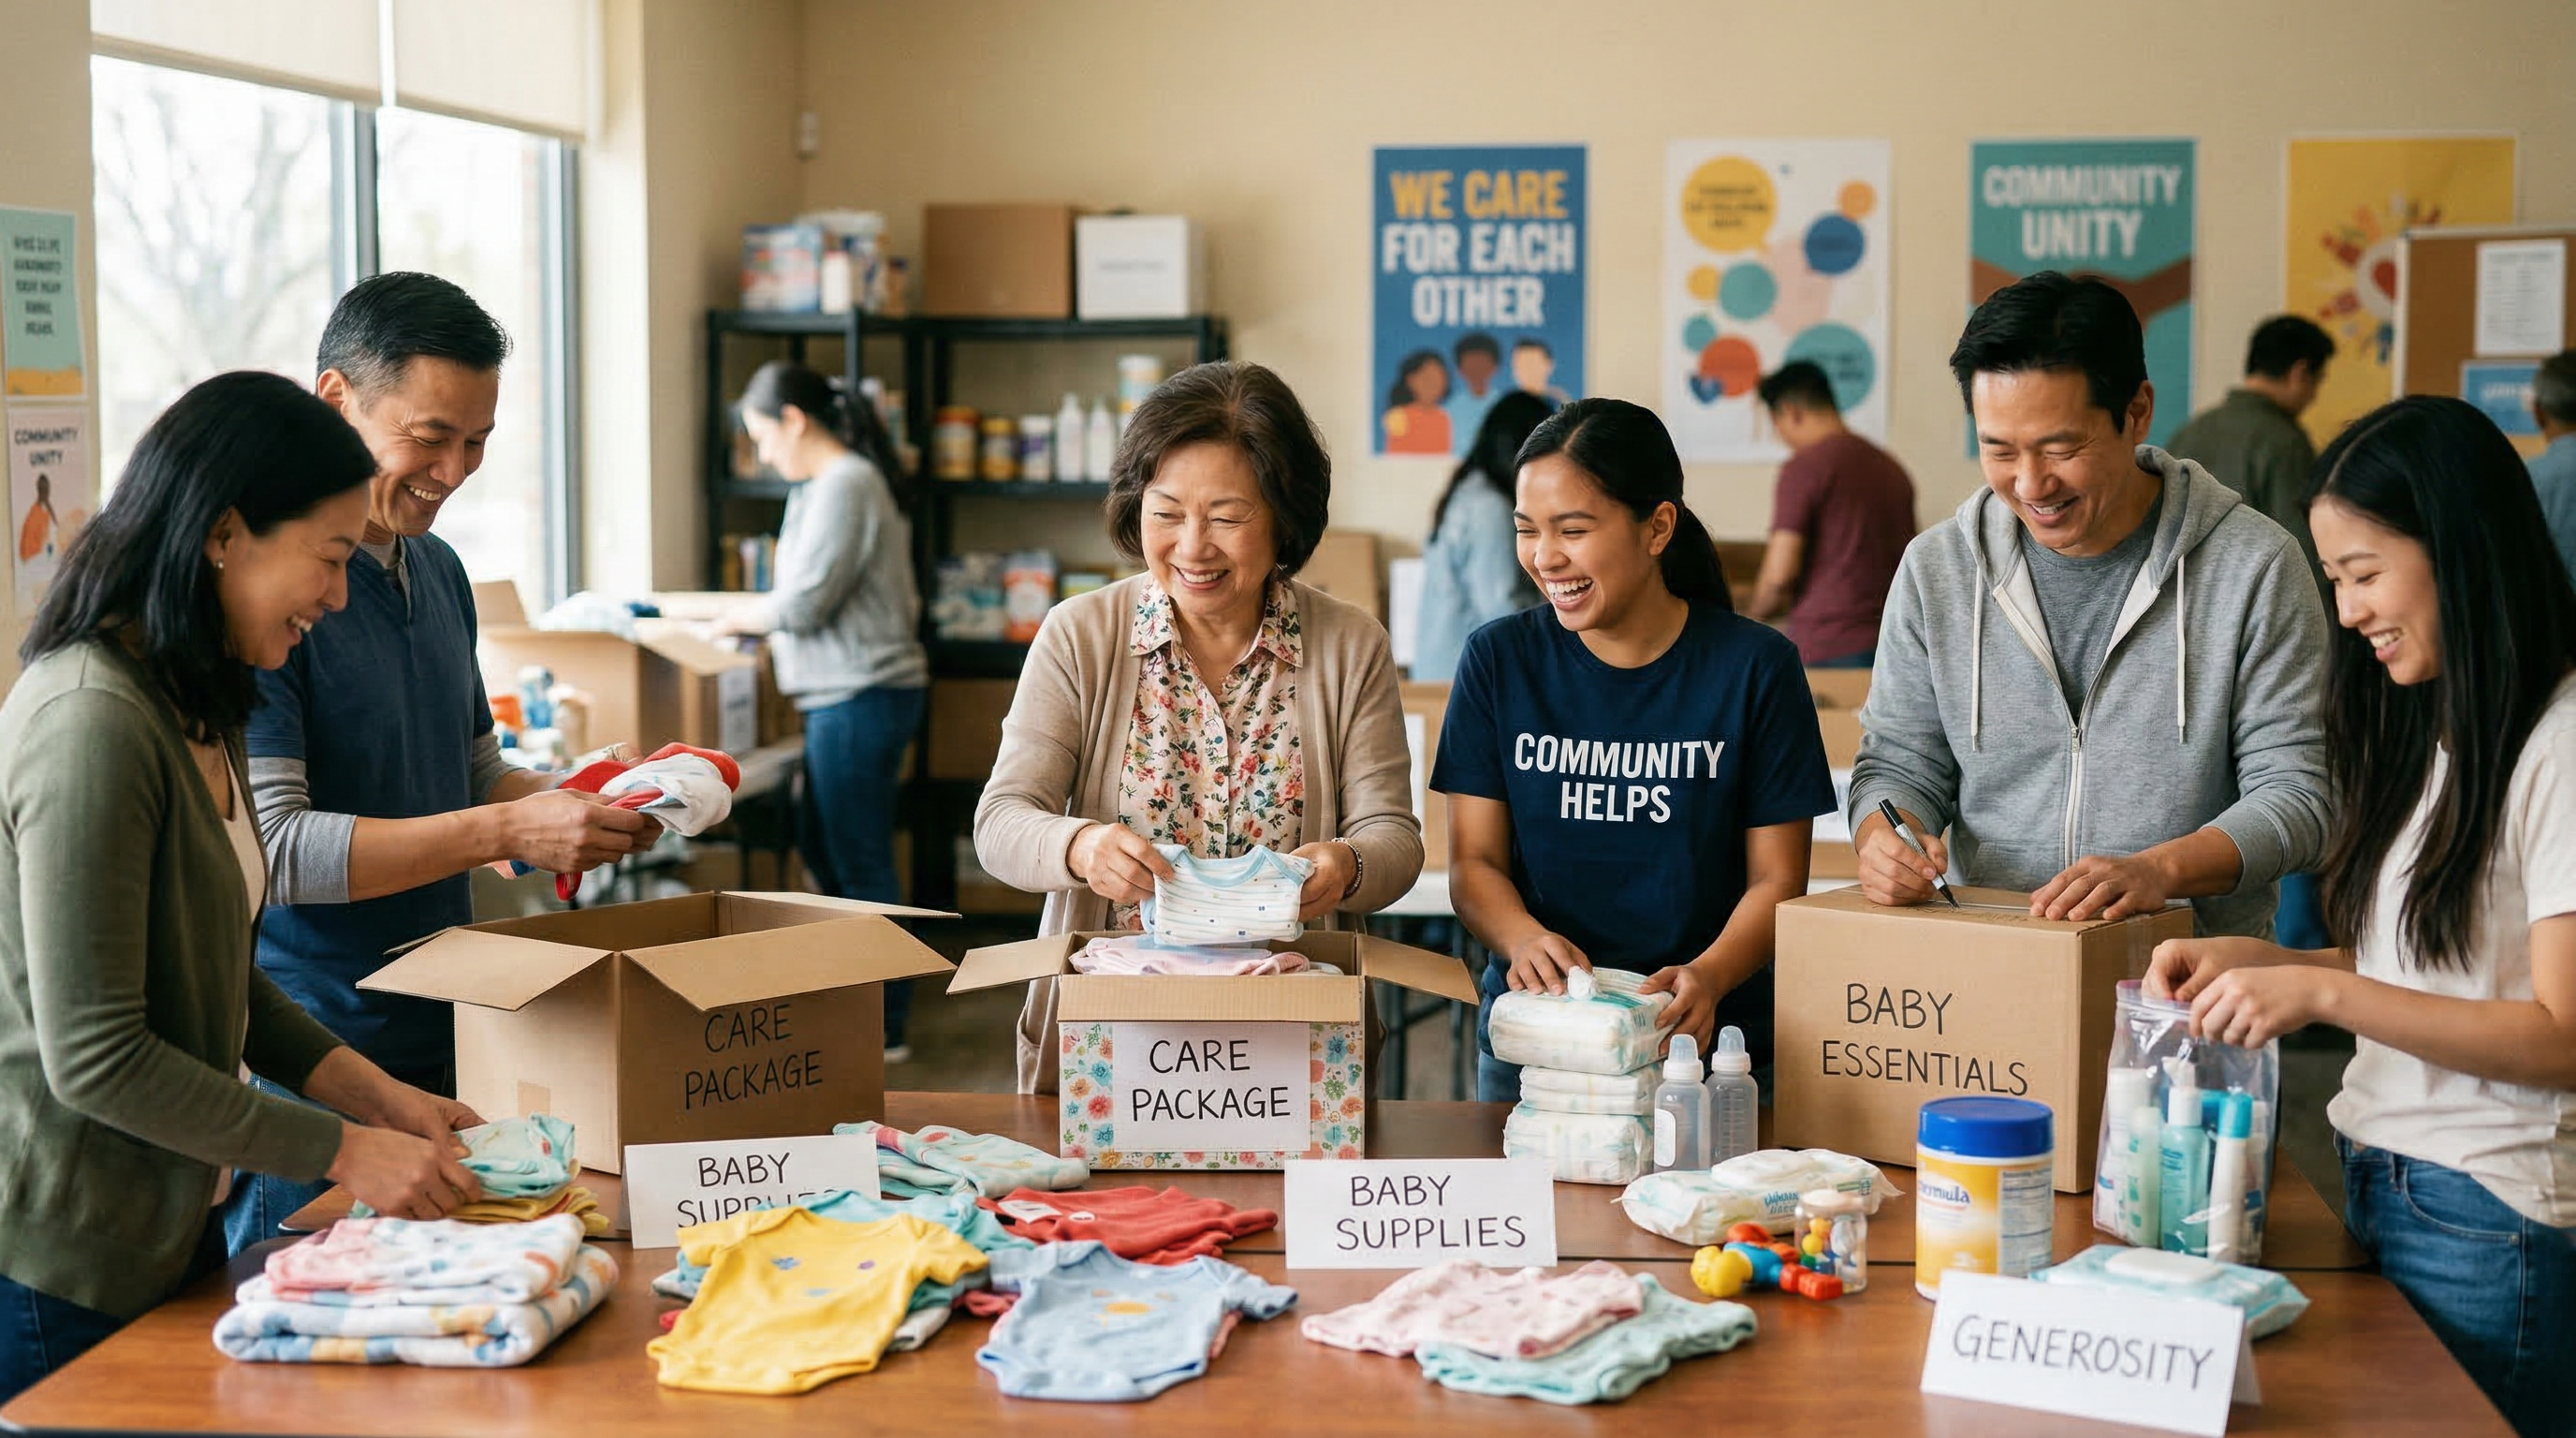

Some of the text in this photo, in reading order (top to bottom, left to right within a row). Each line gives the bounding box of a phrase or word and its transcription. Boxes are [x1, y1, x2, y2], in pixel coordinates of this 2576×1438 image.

[1390, 169, 1568, 218] WE CARE
[1983, 165, 2182, 207] COMMUNITY
[1383, 222, 1575, 273] FOR EACH
[2022, 209, 2142, 260] UNITY
[1412, 275, 1544, 328] OTHER
[15, 427, 78, 445] COMMUNITY
[30, 450, 63, 466] UNITY
[1515, 732, 1725, 779] COMMUNITY
[1560, 781, 1671, 823] HELPS
[705, 1004, 792, 1052] CARE
[1847, 983, 1953, 1034] BABY
[685, 1050, 823, 1109] PACKAGE
[1149, 1040, 1251, 1073] CARE
[1822, 1040, 2027, 1096] ESSENTIALS
[1133, 1087, 1291, 1122] PACKAGE
[698, 1152, 790, 1187] BABY
[1351, 1175, 1451, 1206] BABY
[1337, 1216, 1526, 1250] SUPPLIES
[1954, 1314, 2214, 1389] GENEROSITY
